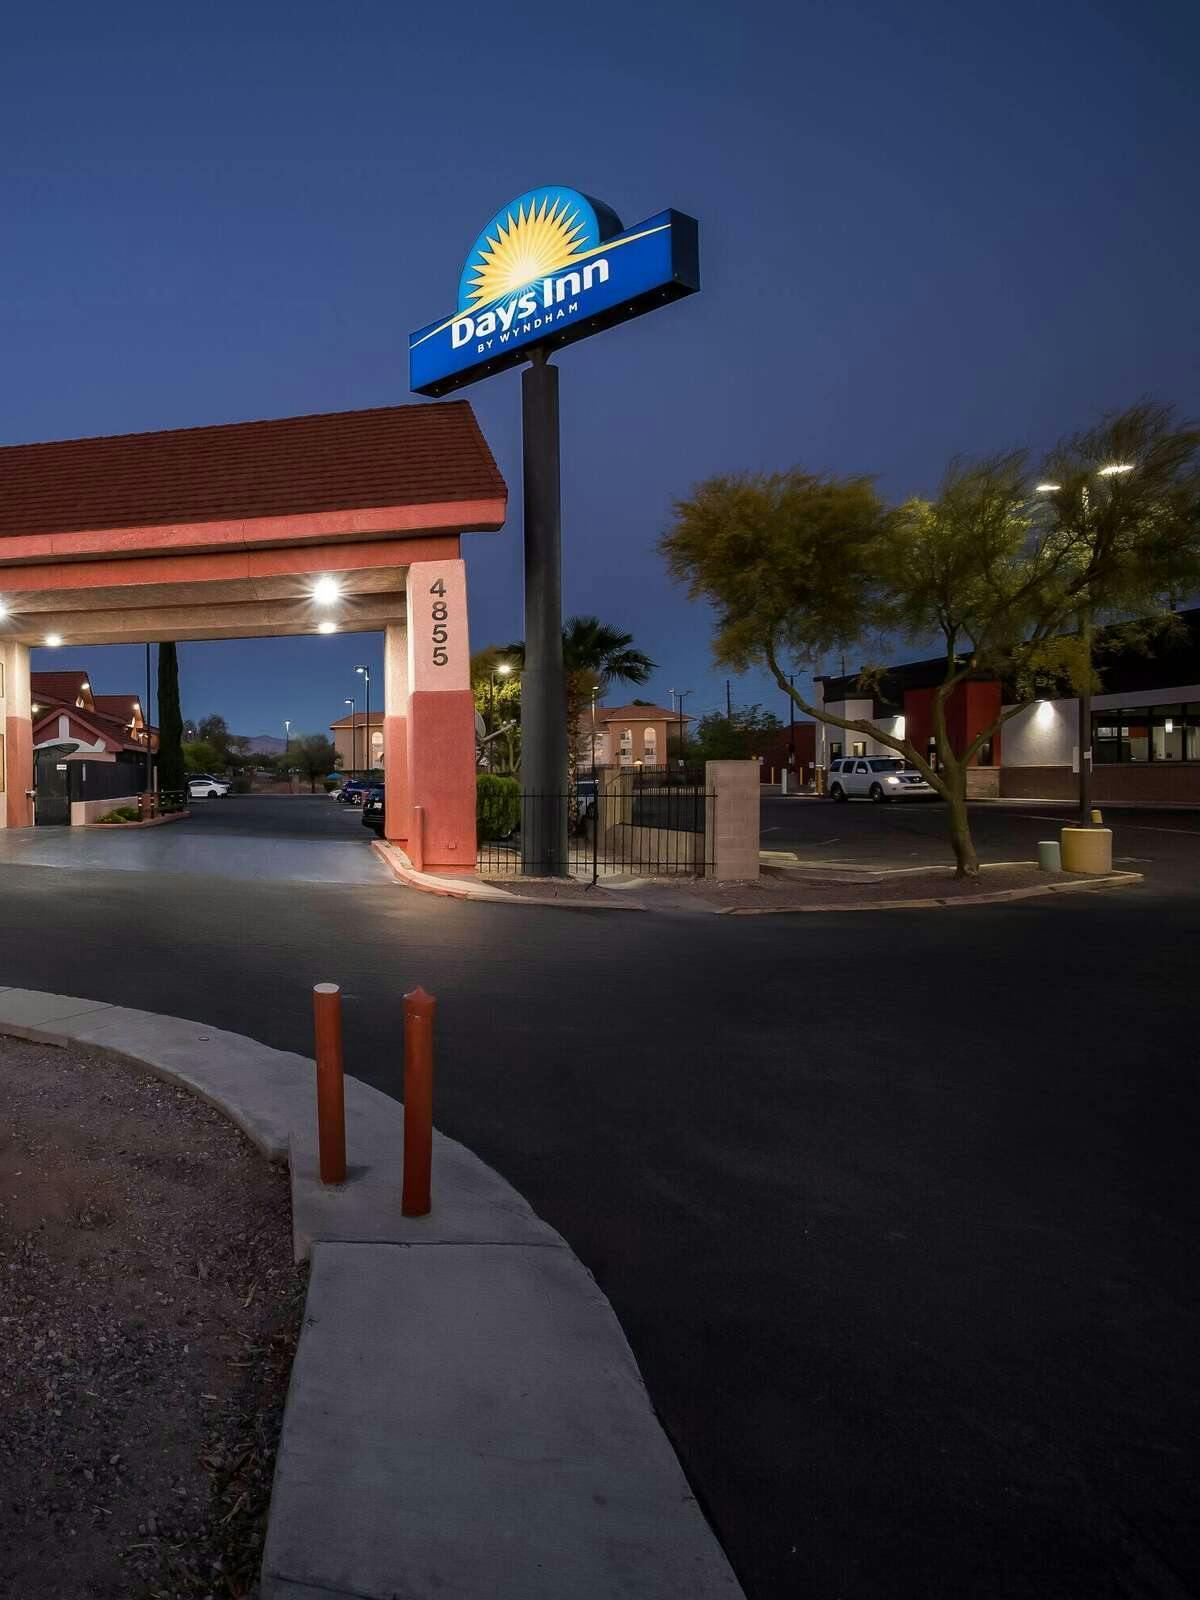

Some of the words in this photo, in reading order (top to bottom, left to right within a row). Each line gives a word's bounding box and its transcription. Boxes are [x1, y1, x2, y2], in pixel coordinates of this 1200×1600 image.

[451, 291, 537, 349] Days
[543, 258, 609, 308] Inn
[477, 338, 494, 353] BY
[499, 302, 578, 344] WYNDHAM
[430, 578, 449, 667] 4855
